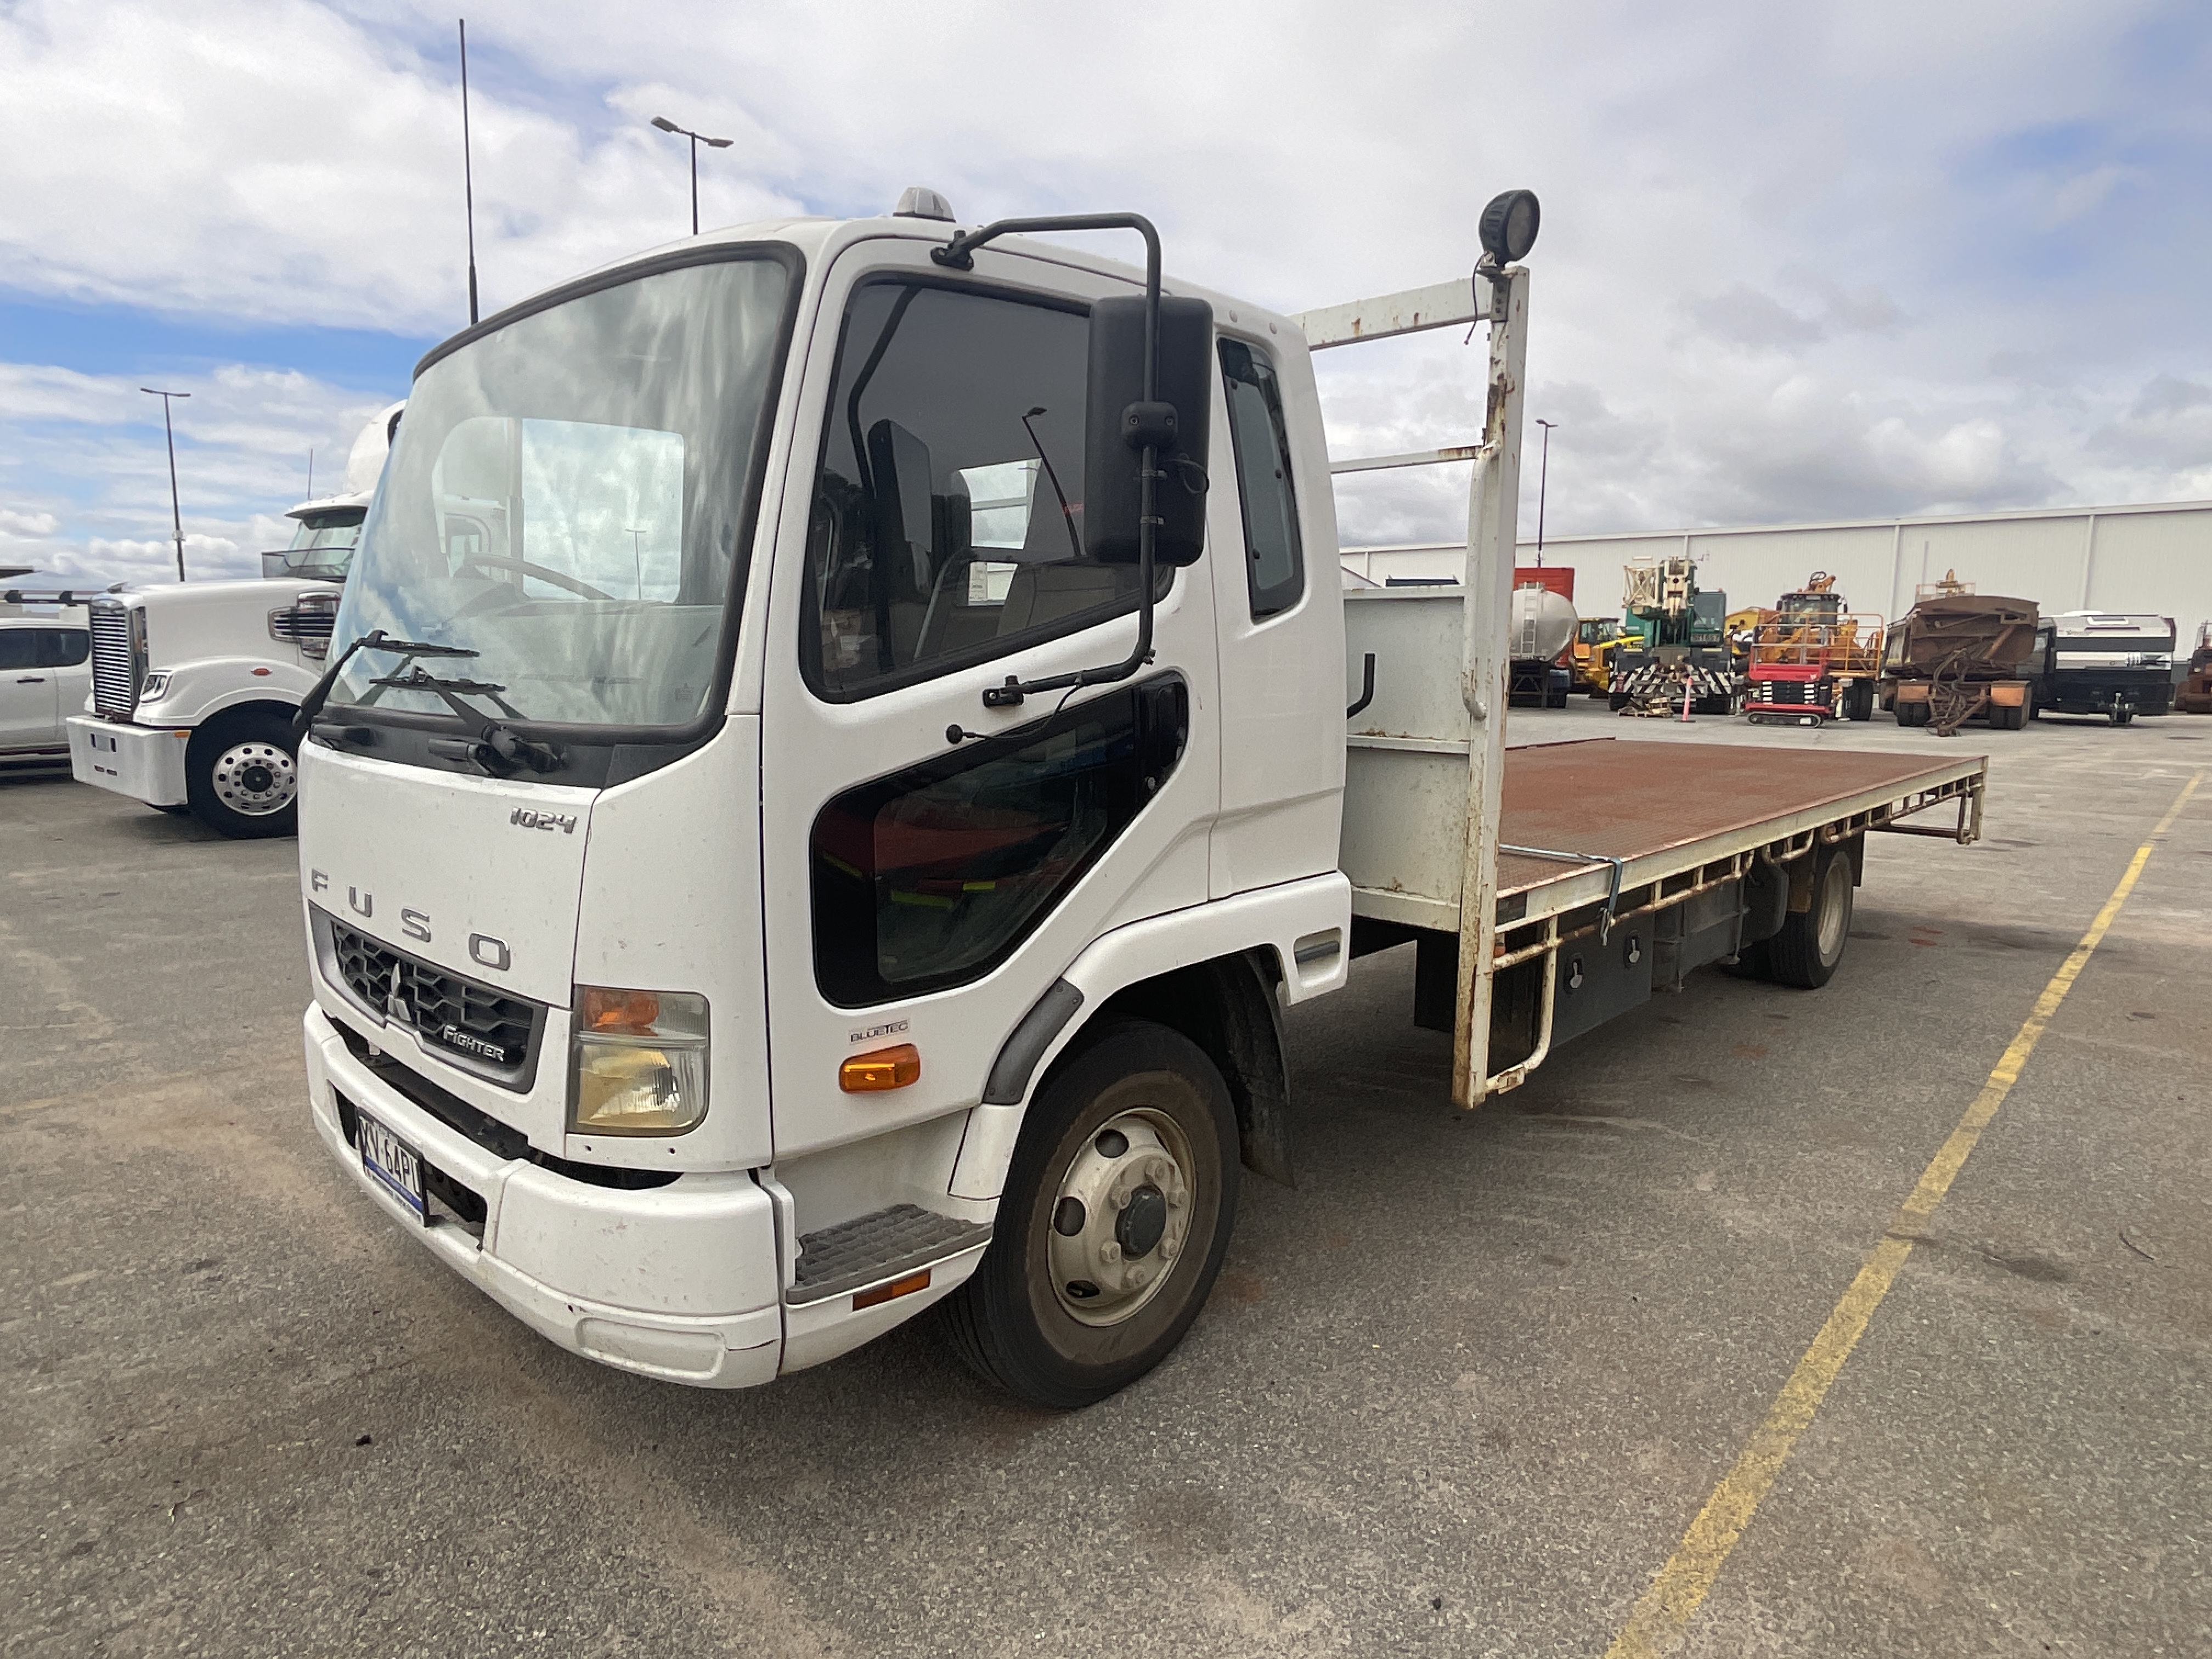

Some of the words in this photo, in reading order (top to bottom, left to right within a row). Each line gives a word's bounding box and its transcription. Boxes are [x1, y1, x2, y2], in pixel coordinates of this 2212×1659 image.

[510, 807, 577, 834] 1024
[312, 868, 511, 971] FUSO
[442, 1026, 505, 1062] FIGHTER
[850, 1019, 909, 1042] BLUETEC
